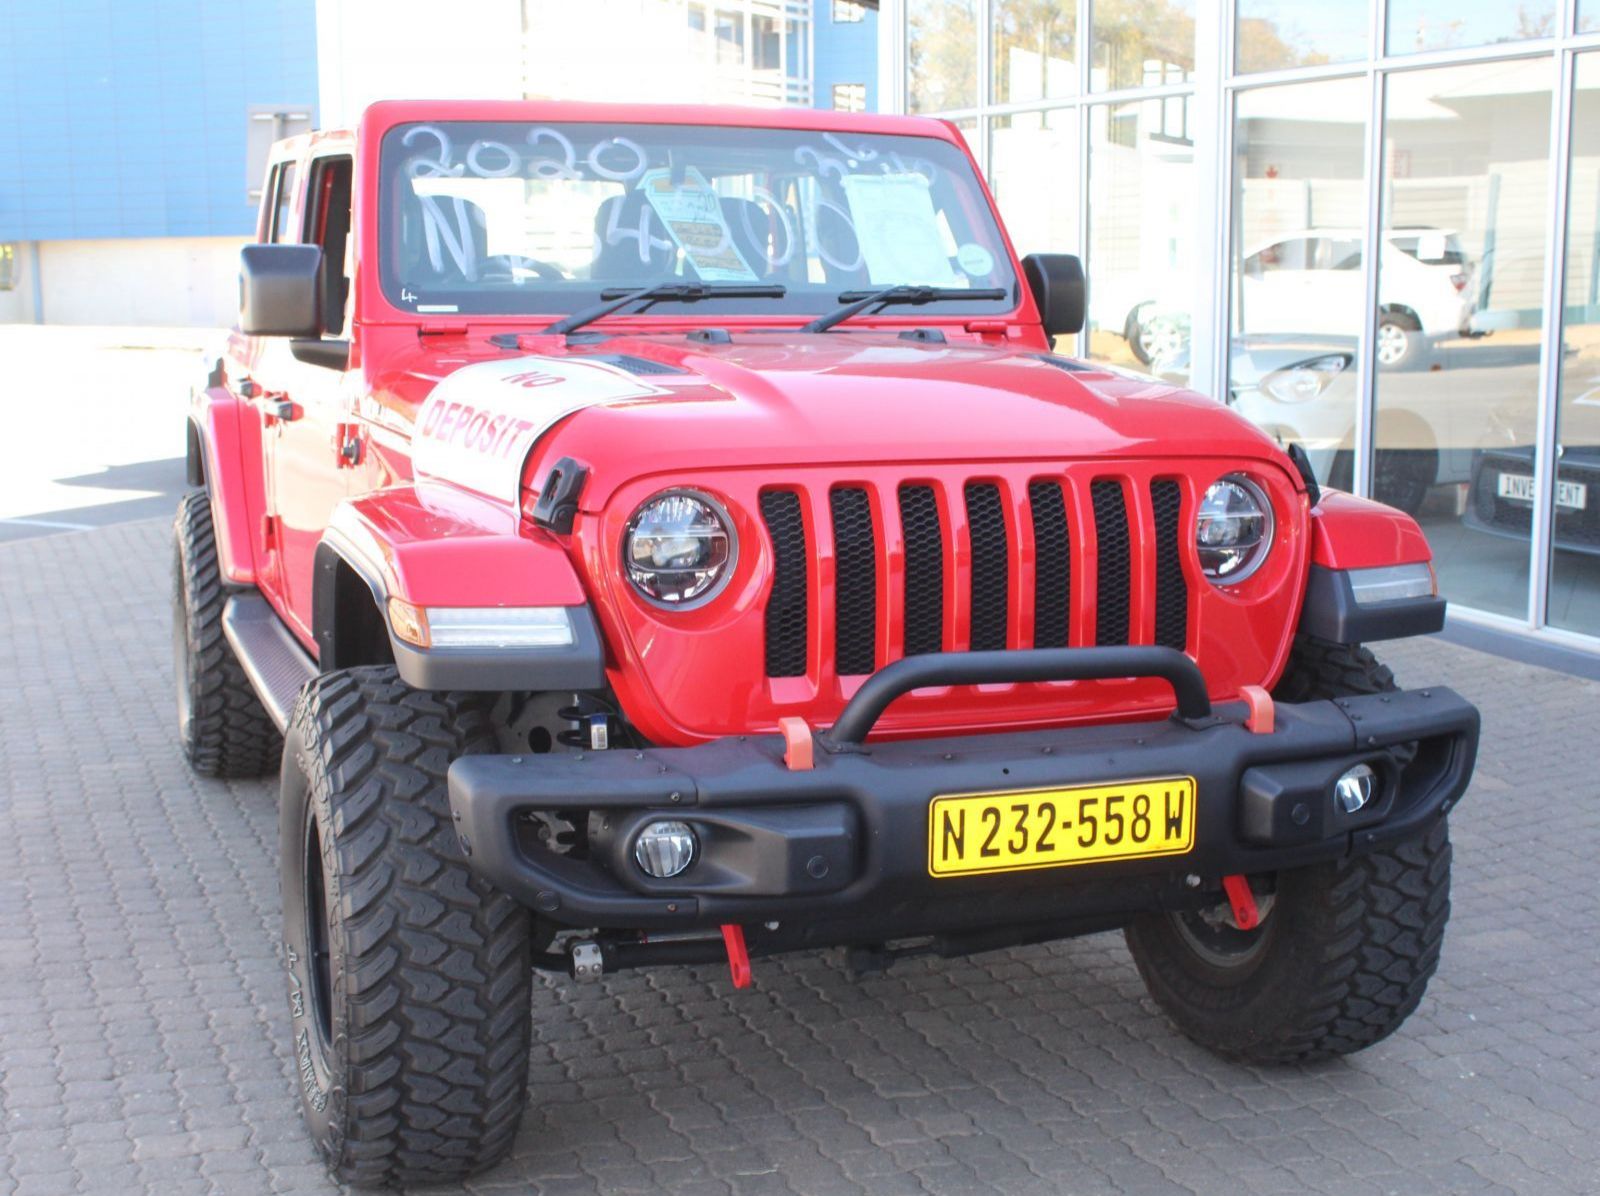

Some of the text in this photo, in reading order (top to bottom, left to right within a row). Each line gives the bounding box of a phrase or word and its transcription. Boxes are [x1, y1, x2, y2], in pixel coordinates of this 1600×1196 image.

[402, 125, 648, 181] 2020
[501, 371, 566, 388] NO
[422, 399, 535, 459] DEPOSIT
[1504, 476, 1581, 504] INVEENT
[942, 790, 1185, 861] N 232-558 W
